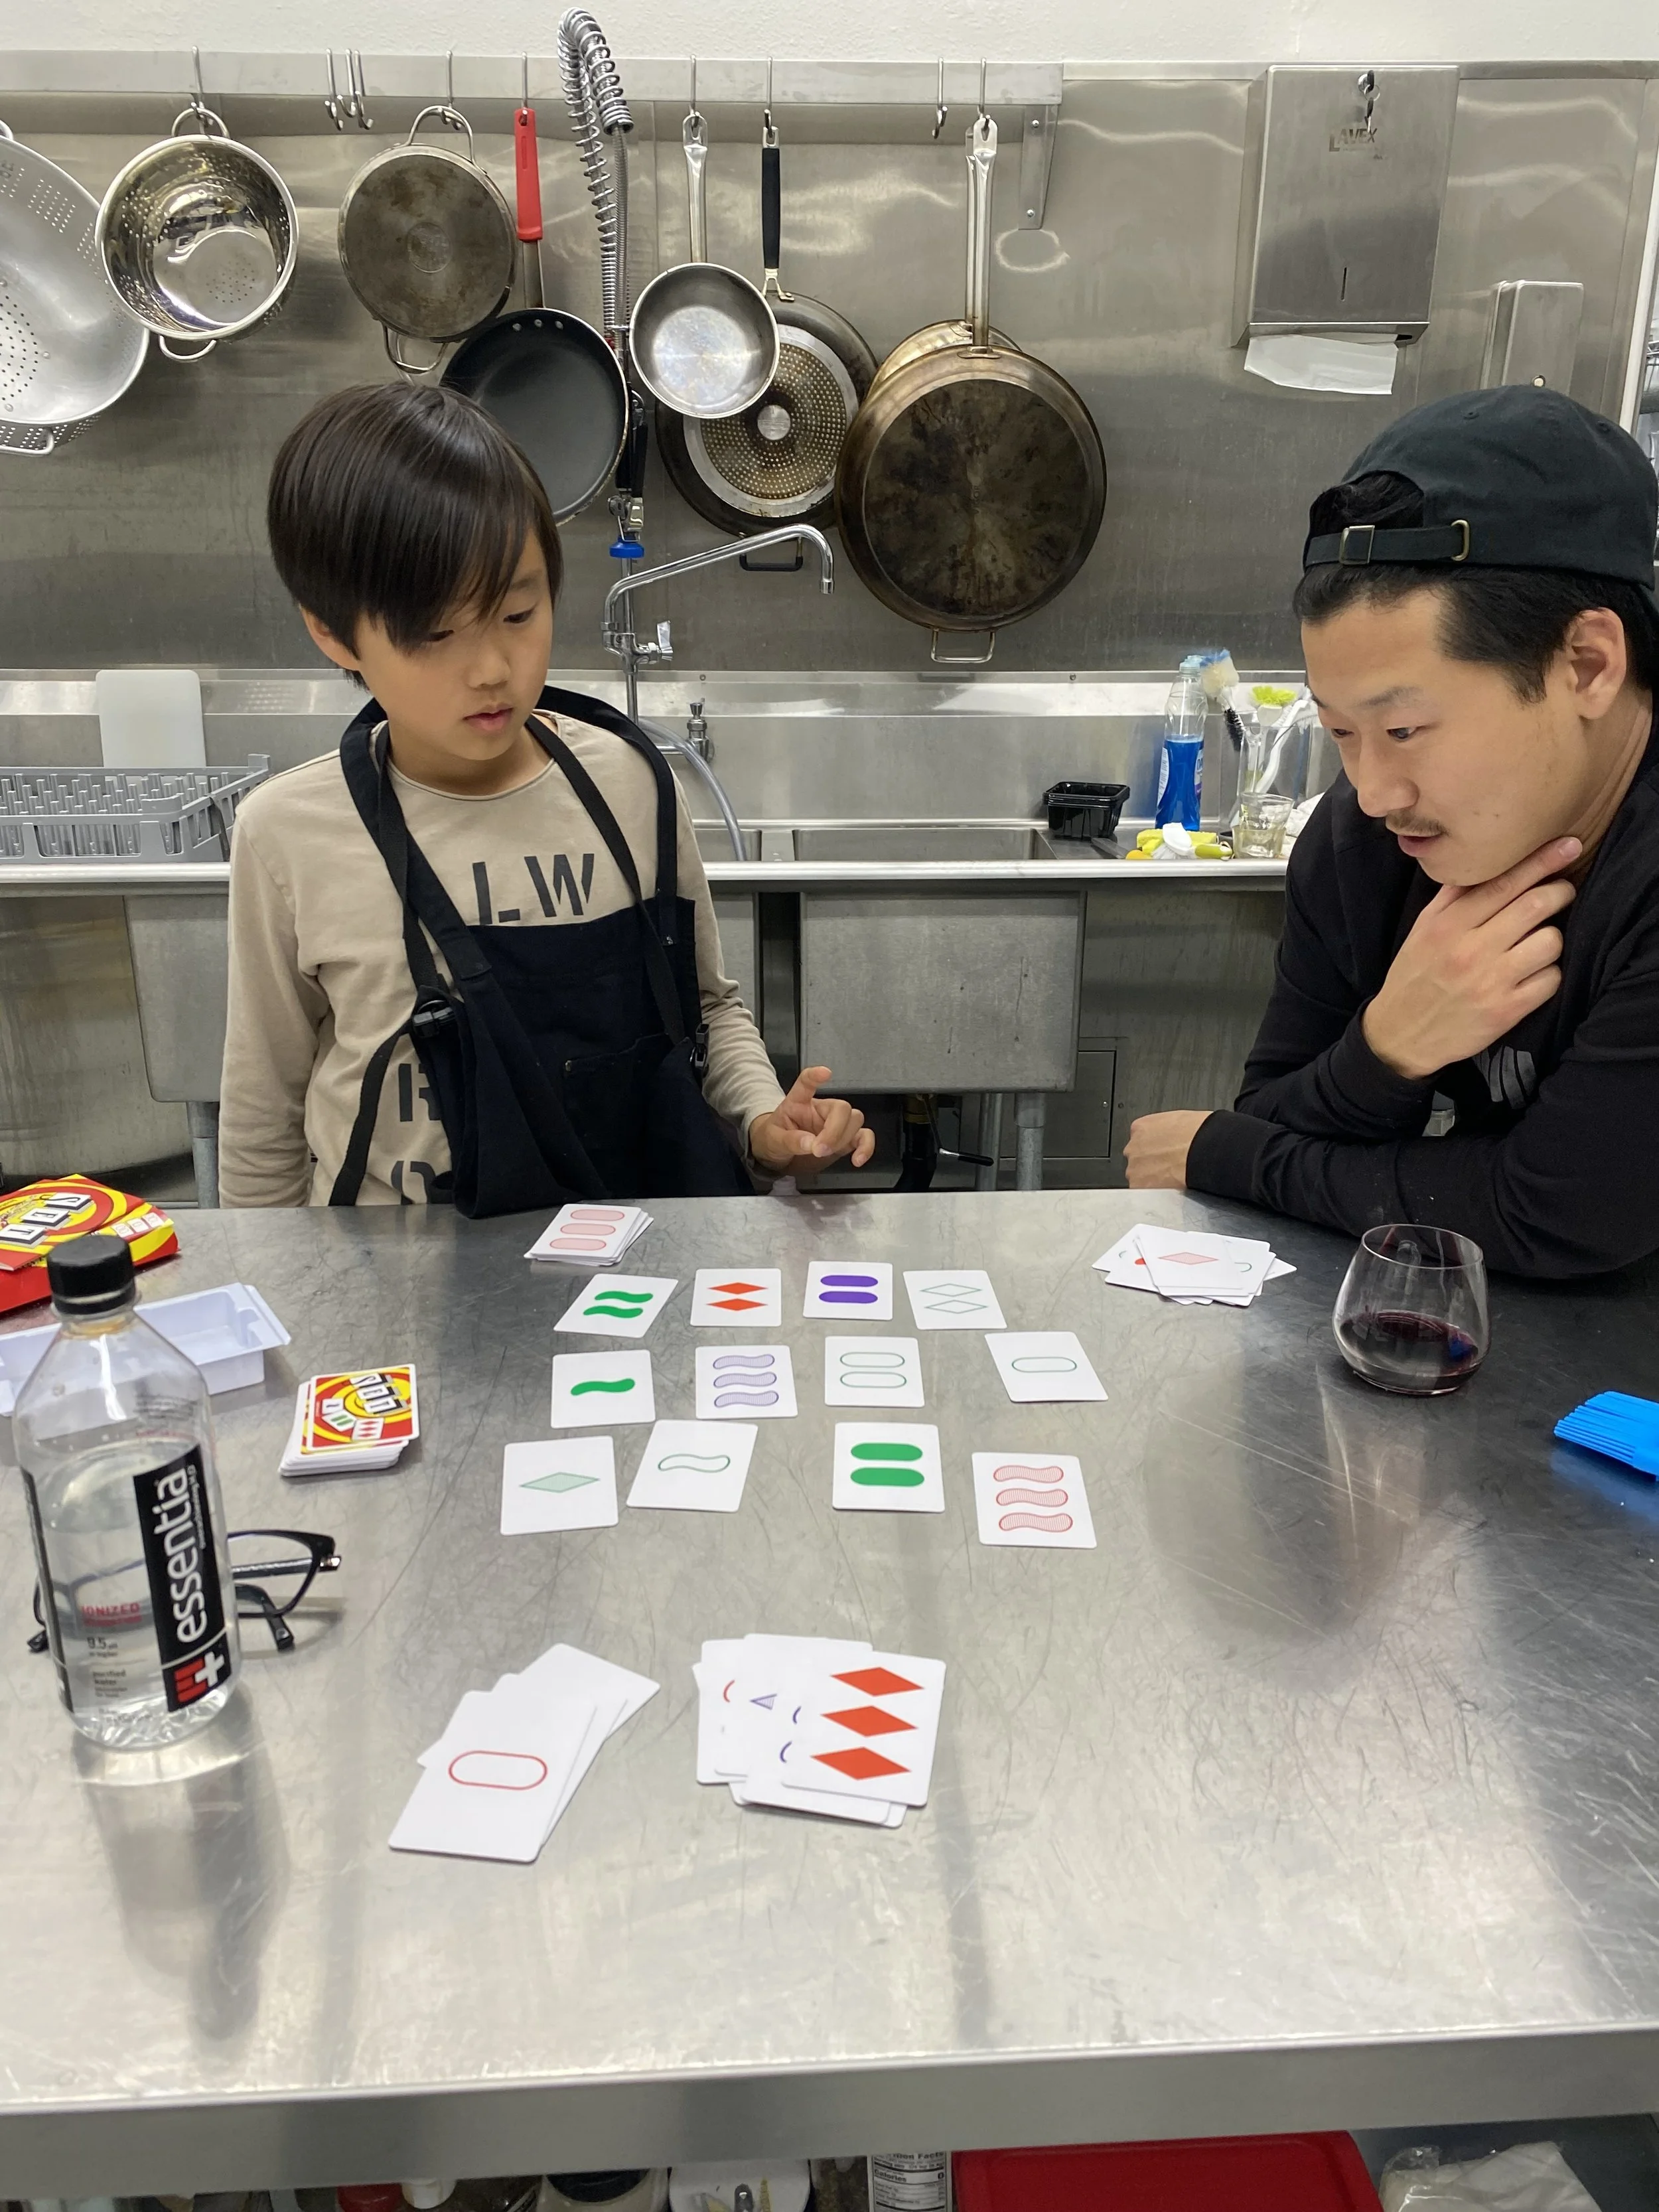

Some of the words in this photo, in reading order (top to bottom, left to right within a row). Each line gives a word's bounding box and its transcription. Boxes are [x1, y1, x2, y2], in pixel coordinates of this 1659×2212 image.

[1329, 128, 1378, 152] LAVEX
[4, 1194, 84, 1237] SET
[351, 1374, 393, 1410] SET
[152, 1467, 208, 1643] essentia
[82, 1602, 140, 1616] IONIZED
[875, 2169, 906, 2182] Calories
